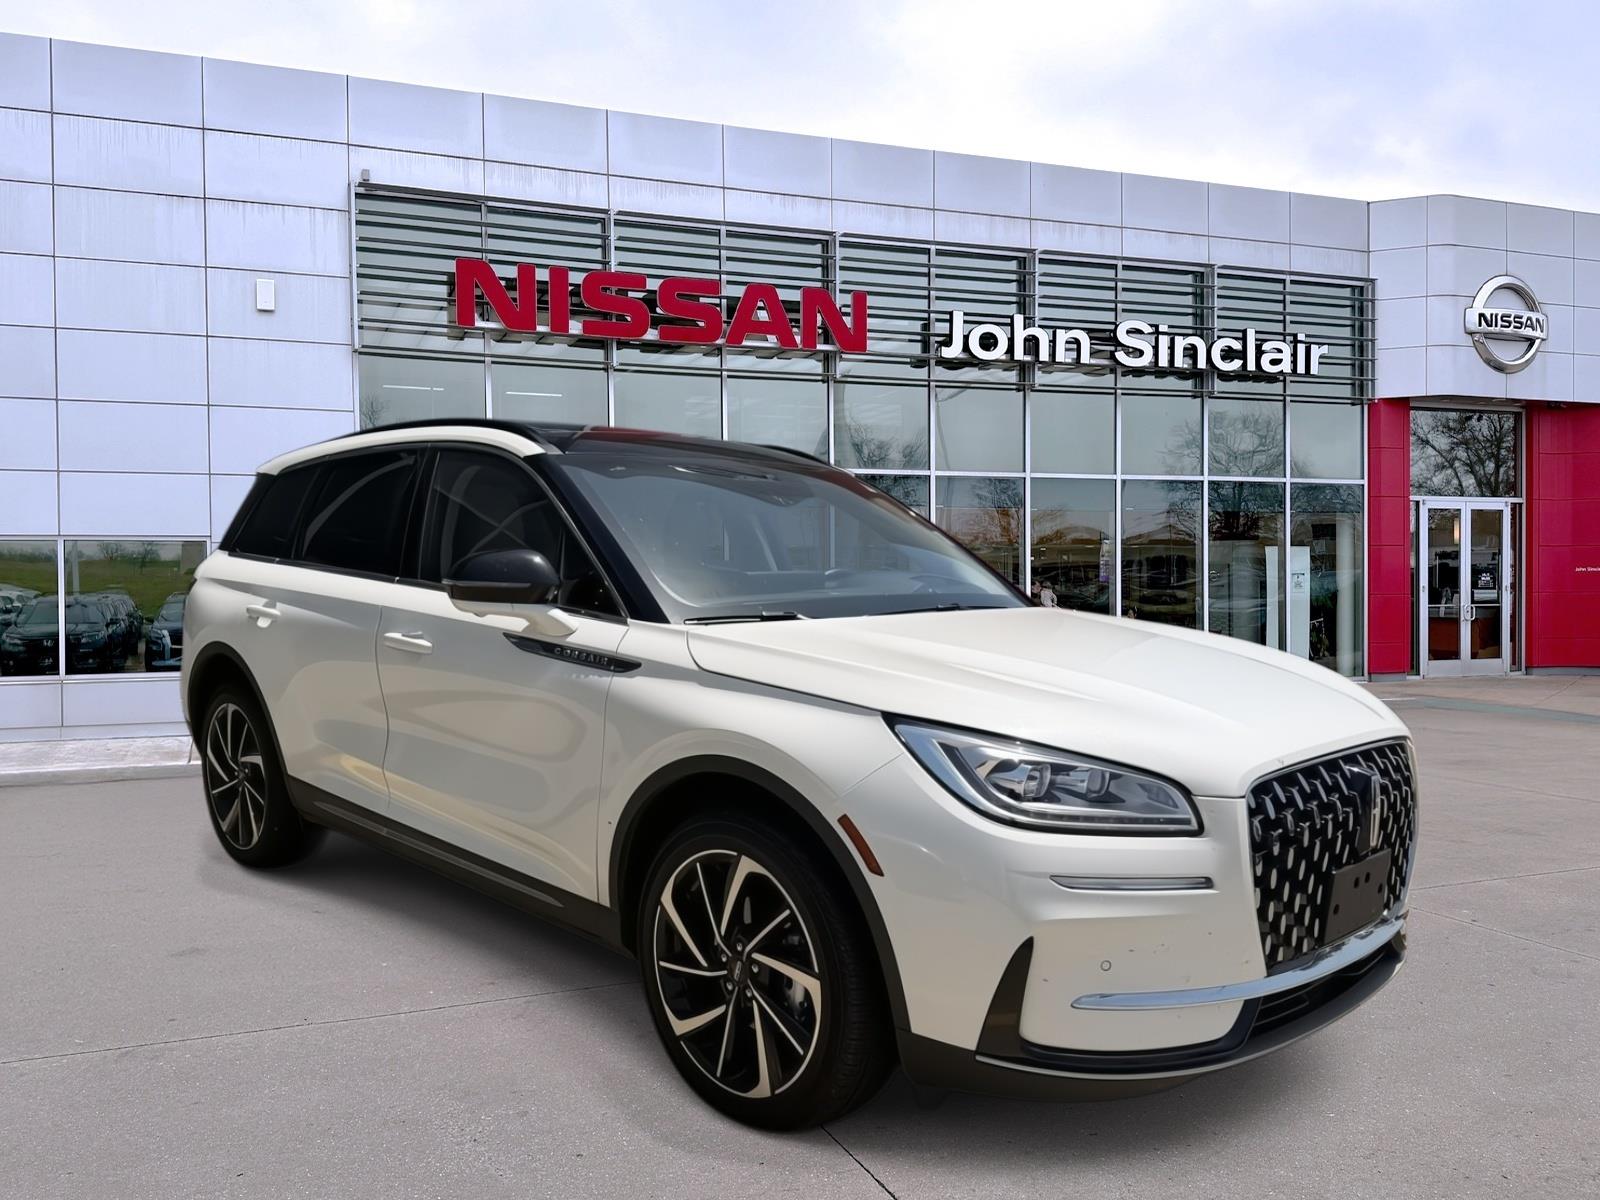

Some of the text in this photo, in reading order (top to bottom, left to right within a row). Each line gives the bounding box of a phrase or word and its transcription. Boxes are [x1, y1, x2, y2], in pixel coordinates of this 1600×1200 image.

[455, 257, 868, 353] NISSAN
[1478, 312, 1544, 333] NISSAN
[941, 310, 1329, 375] John Sinclair
[554, 647, 608, 665] CORSAIR
